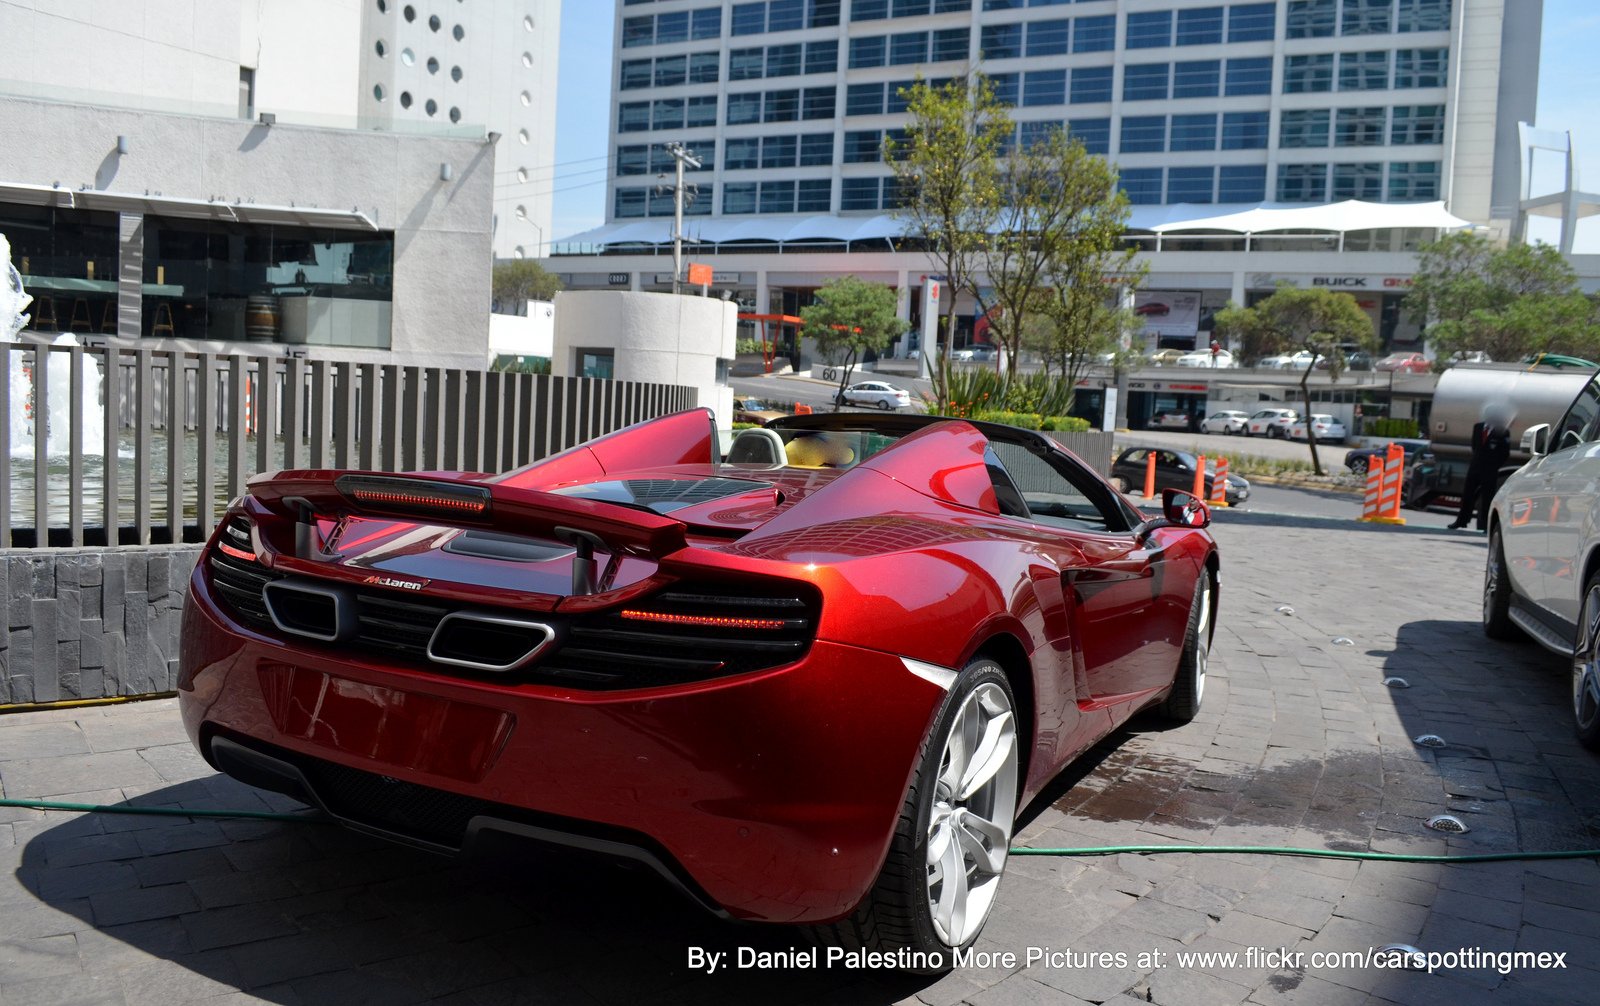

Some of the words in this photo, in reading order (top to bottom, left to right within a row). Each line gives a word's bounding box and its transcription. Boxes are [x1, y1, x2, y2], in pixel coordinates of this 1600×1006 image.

[1312, 277, 1367, 287] BUICK
[822, 367, 837, 381] 60
[363, 575, 422, 590] McLaren
